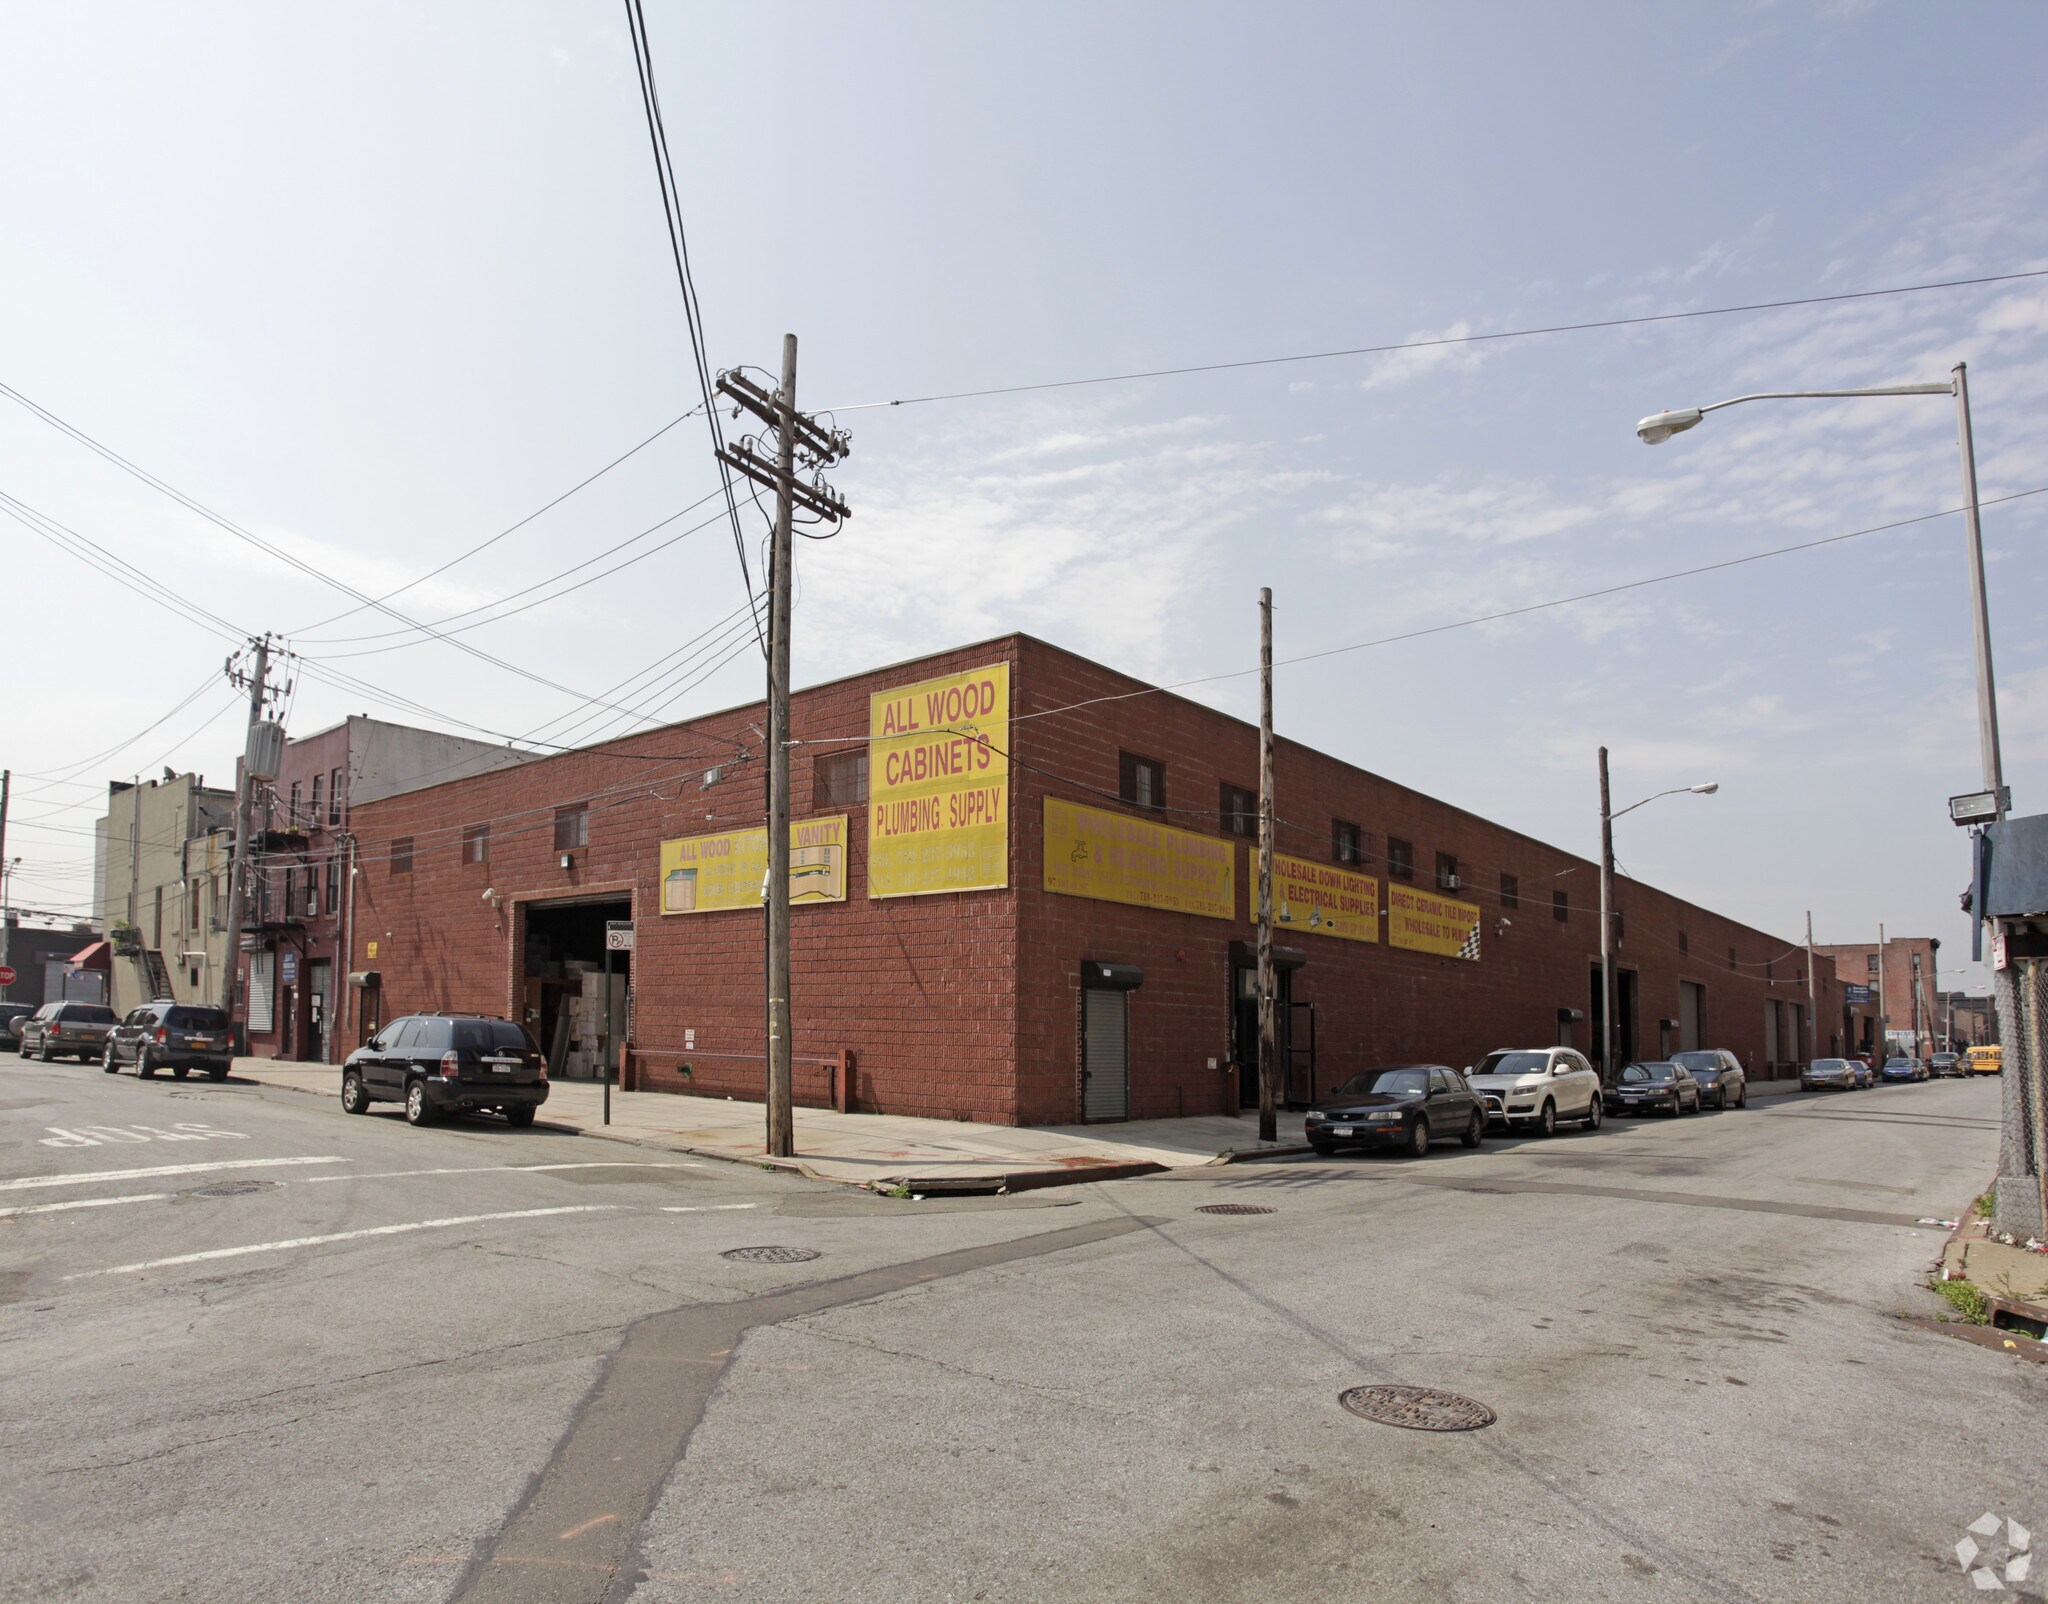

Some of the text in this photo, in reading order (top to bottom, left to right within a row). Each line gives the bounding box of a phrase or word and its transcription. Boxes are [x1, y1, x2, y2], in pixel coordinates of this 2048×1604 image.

[882, 680, 996, 737] ALL WOOD
[885, 732, 991, 787] CABINETS
[876, 796, 940, 837] PLUMBING
[949, 787, 1001, 829] SUPPLY
[679, 843, 697, 862] ALL
[700, 838, 731, 860] WOOD
[734, 834, 767, 855] KITCH
[797, 822, 842, 847] VANITY
[1075, 811, 1161, 849] WHOLESALE
[1165, 832, 1228, 864] PLUMBING
[1093, 843, 1219, 885] & HEATING SUPPLY
[1273, 858, 1317, 884] HOLESALE
[1319, 869, 1342, 889] DOWN
[1343, 876, 1376, 898] LIGHTING
[1288, 884, 1338, 910] ELECTRICAL
[1340, 896, 1375, 917] SUPPLIES
[1391, 891, 1478, 925] DIRECT CERAMIC TILE IMPORT
[1404, 917, 1441, 938] WHOLESALE
[1442, 925, 1450, 940] TO
[0, 971, 15, 980] TOP
